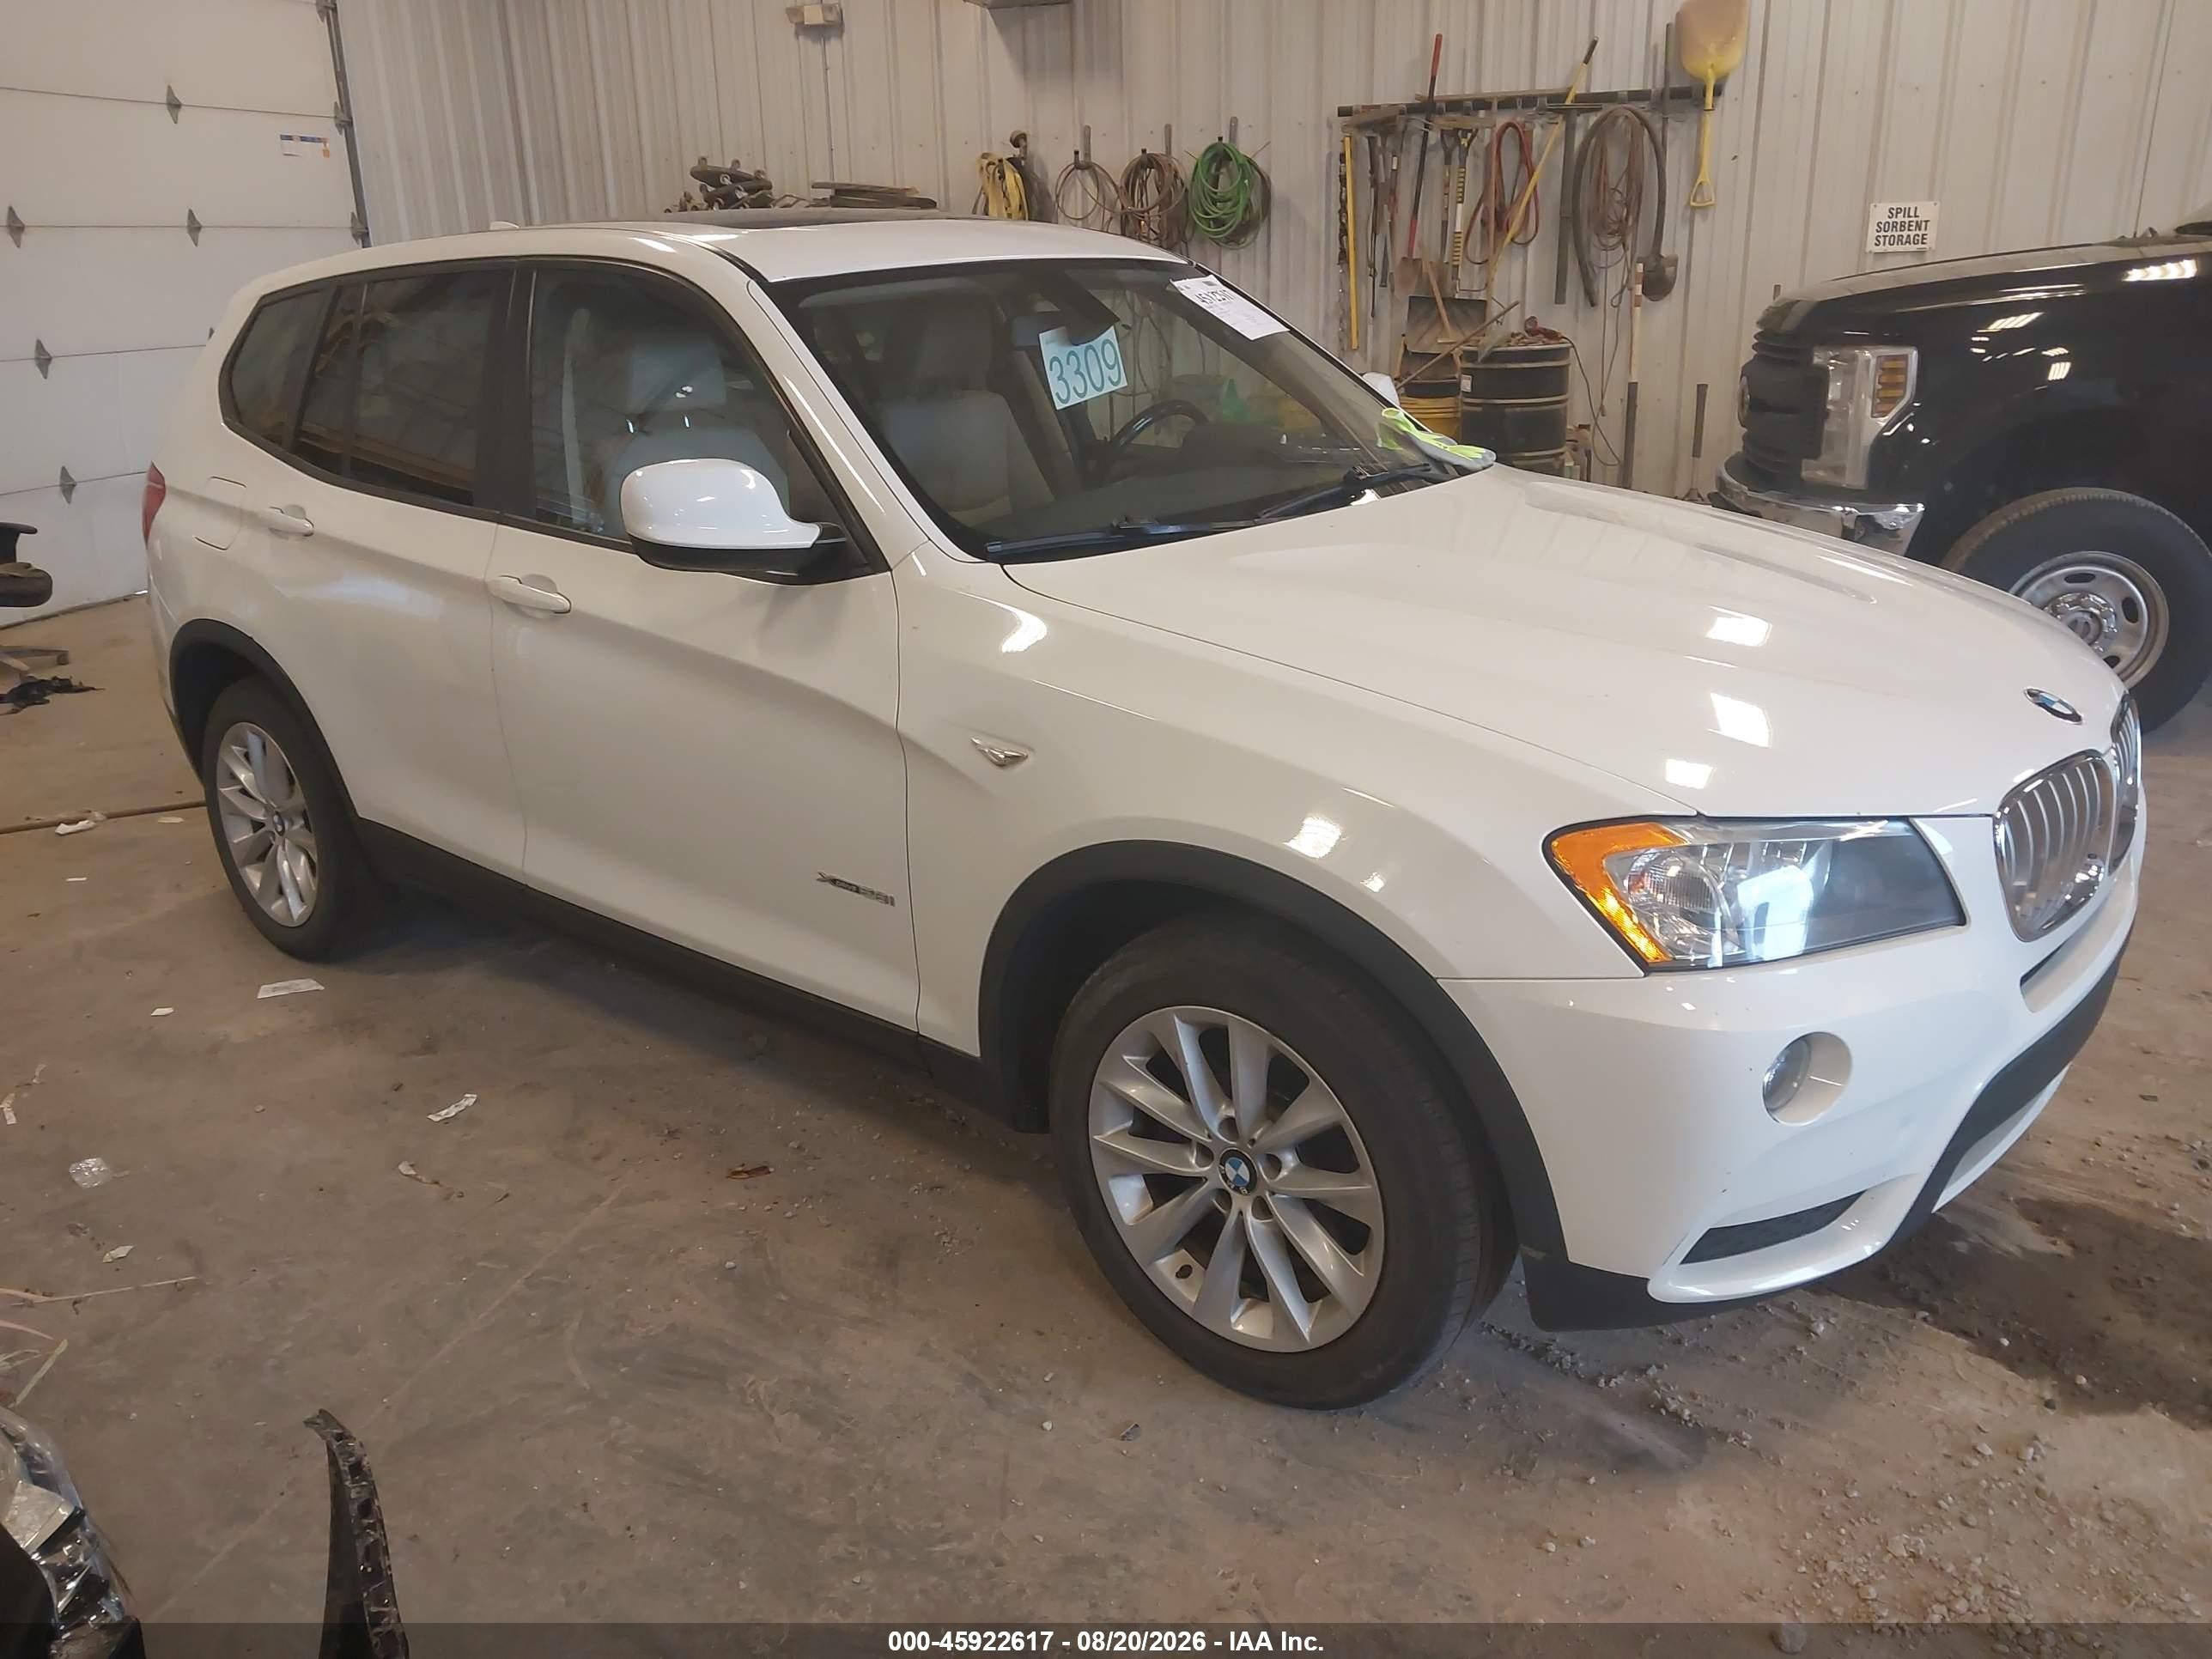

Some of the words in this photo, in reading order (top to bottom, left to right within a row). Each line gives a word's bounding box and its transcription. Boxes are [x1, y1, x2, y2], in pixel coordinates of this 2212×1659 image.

[1887, 206, 1920, 219] SPILL
[1875, 220, 1930, 233] SORBENT
[1874, 234, 1928, 246] STORAGE
[1049, 338, 1121, 404] 3309
